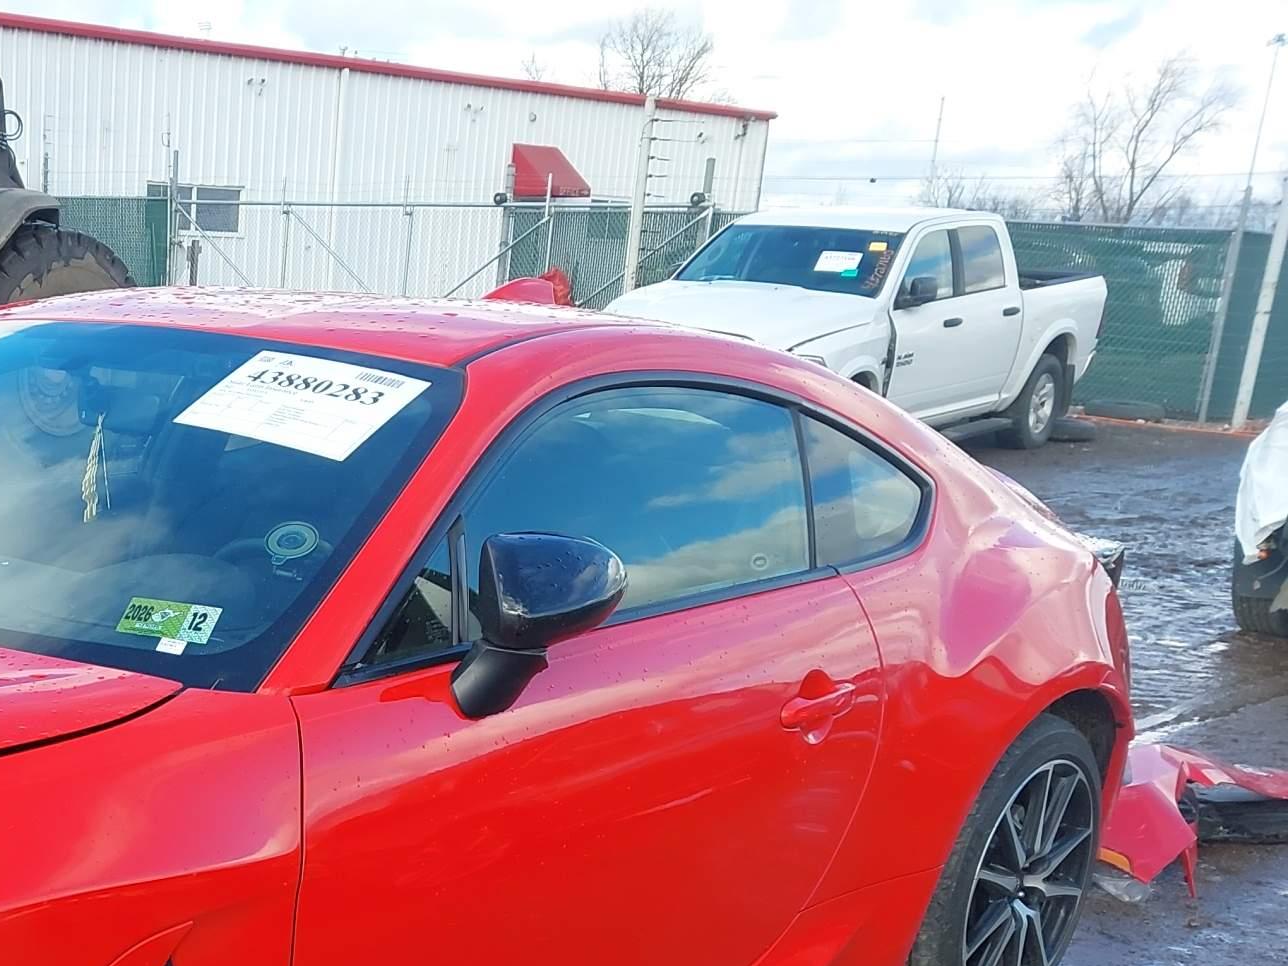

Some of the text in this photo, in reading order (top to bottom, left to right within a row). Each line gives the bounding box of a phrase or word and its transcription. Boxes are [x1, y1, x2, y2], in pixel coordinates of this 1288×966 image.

[247, 369, 385, 406] 43880283
[124, 604, 209, 632] 2026 12
